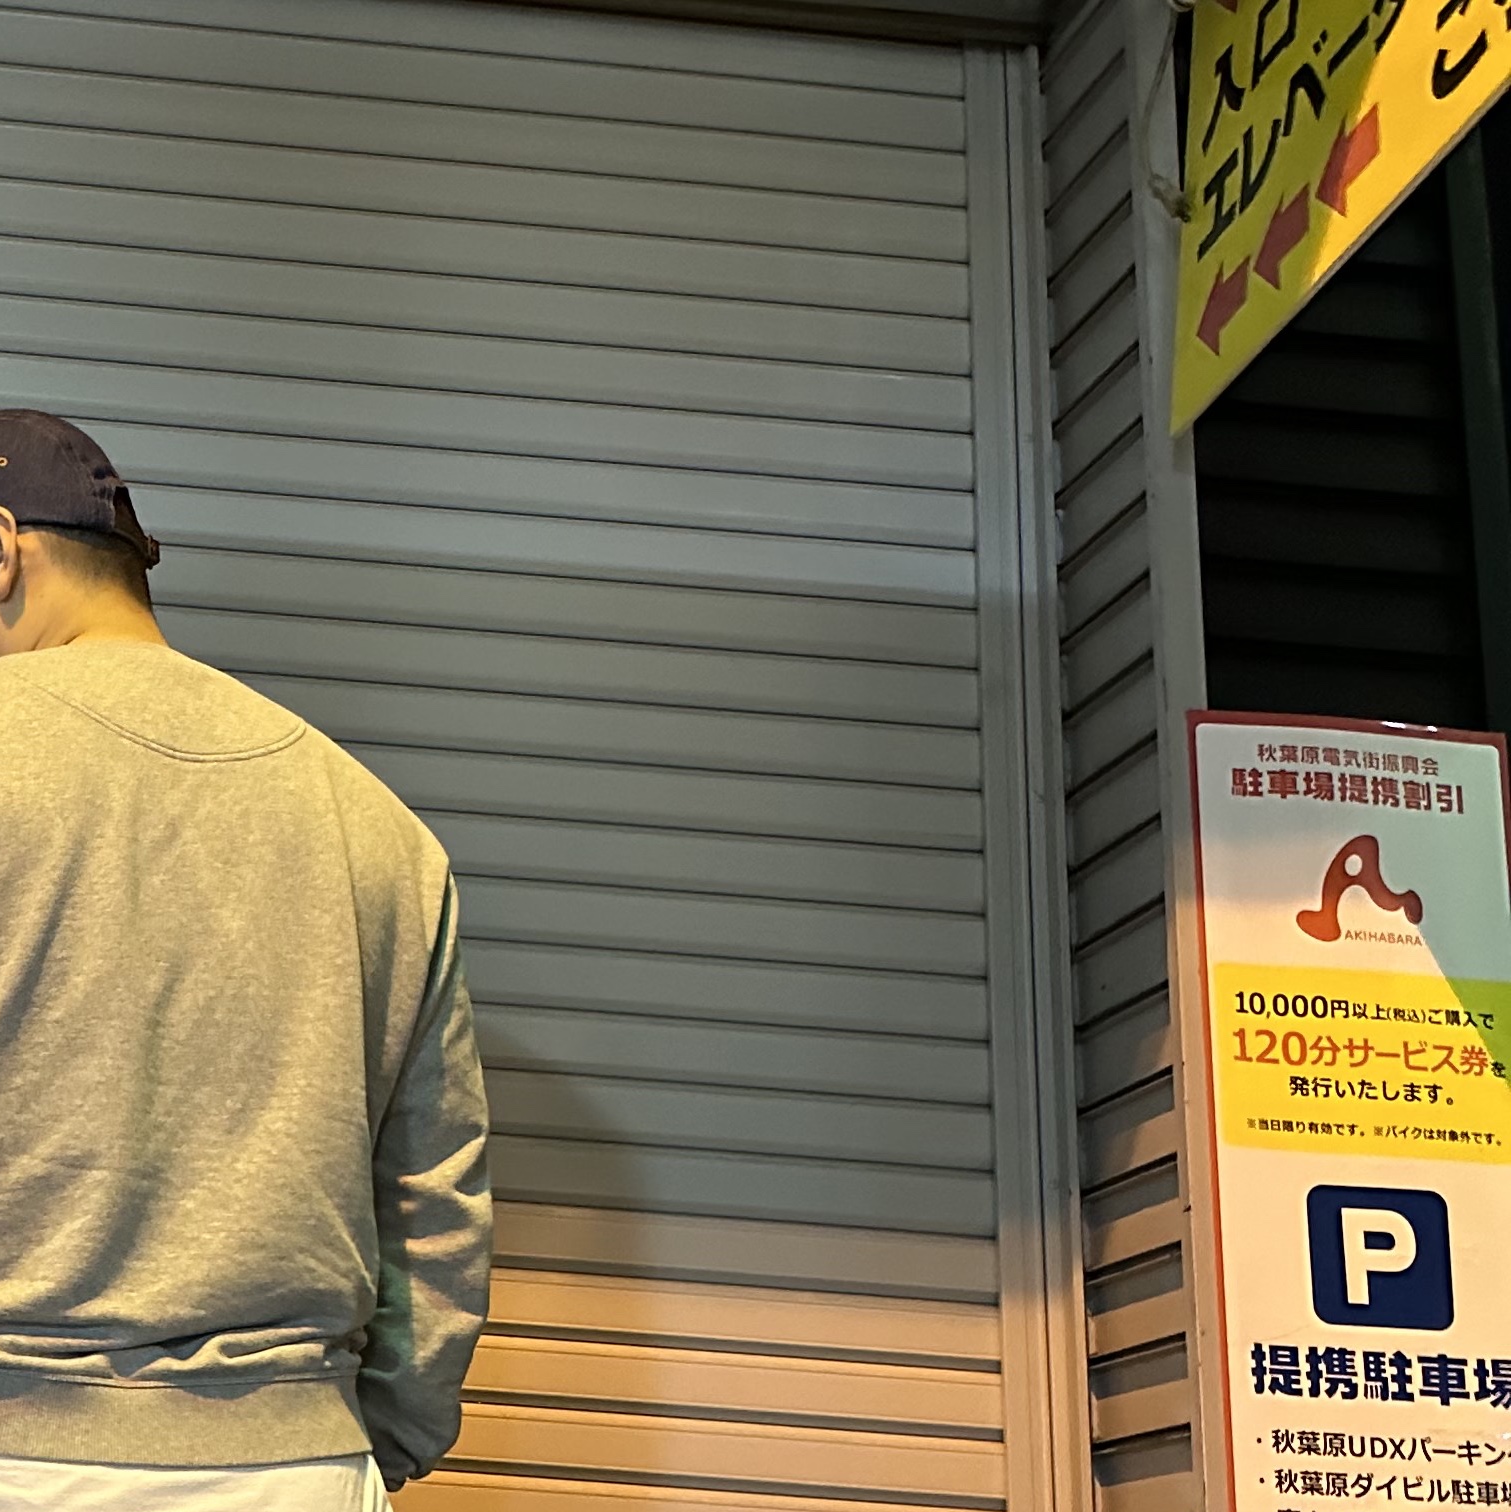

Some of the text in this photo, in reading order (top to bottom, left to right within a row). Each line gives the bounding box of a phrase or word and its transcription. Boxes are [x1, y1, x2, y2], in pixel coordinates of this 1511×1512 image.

[1256, 743, 1440, 777] 秋葉原電気街振興会
[1230, 767, 1465, 815] 駐車場提携割引
[1343, 929, 1424, 947] AKIHABARA
[1232, 1027, 1507, 1079] 120分サービス券を
[1288, 1075, 1455, 1106] 発行いたします。
[1341, 1207, 1418, 1305] P
[1250, 1342, 1511, 1411] 提携駐車場
[1255, 1428, 1511, 1466] ・秋葉原UDXパーキン
